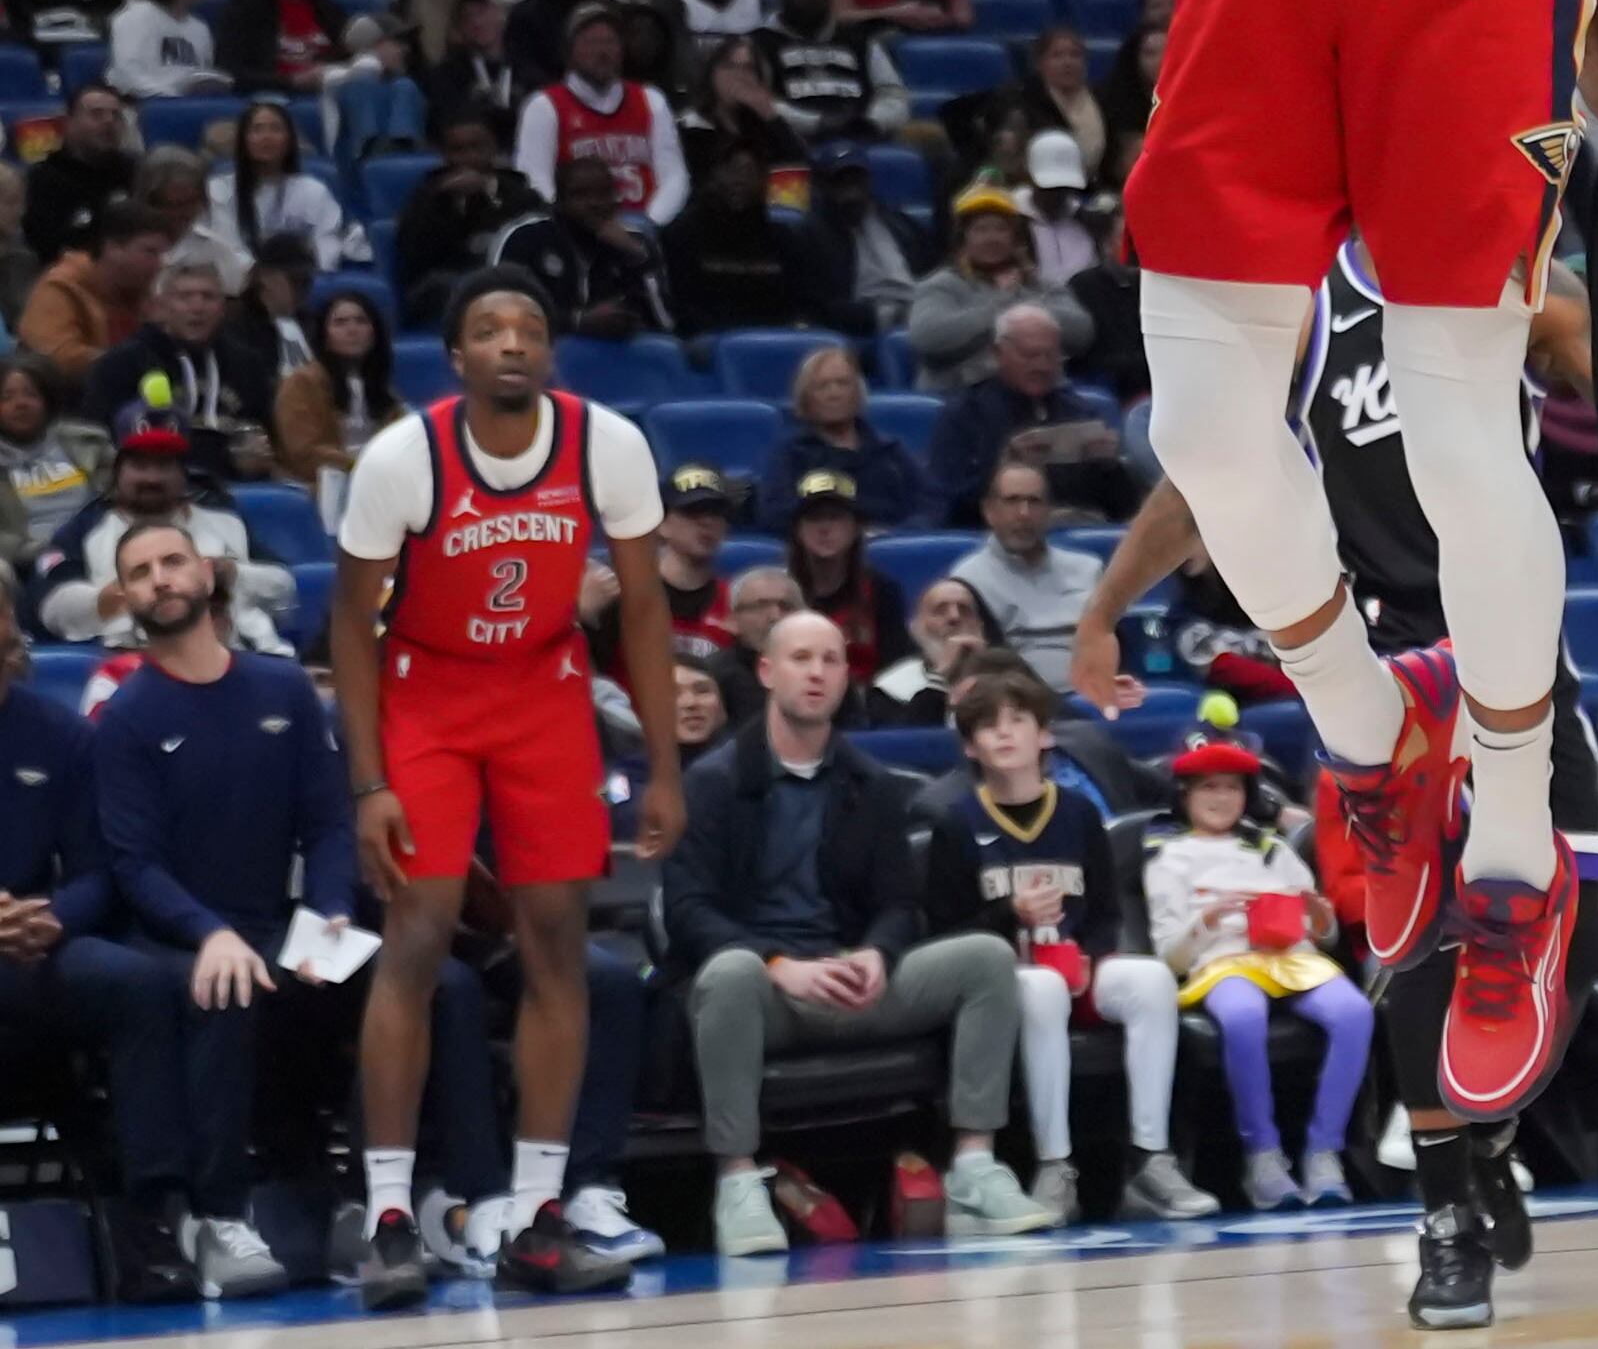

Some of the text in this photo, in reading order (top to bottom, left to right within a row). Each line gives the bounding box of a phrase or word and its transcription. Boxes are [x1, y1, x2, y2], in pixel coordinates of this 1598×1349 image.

[443, 510, 579, 557] CRESCENT
[488, 557, 530, 612] 2
[466, 616, 531, 645] CITY
